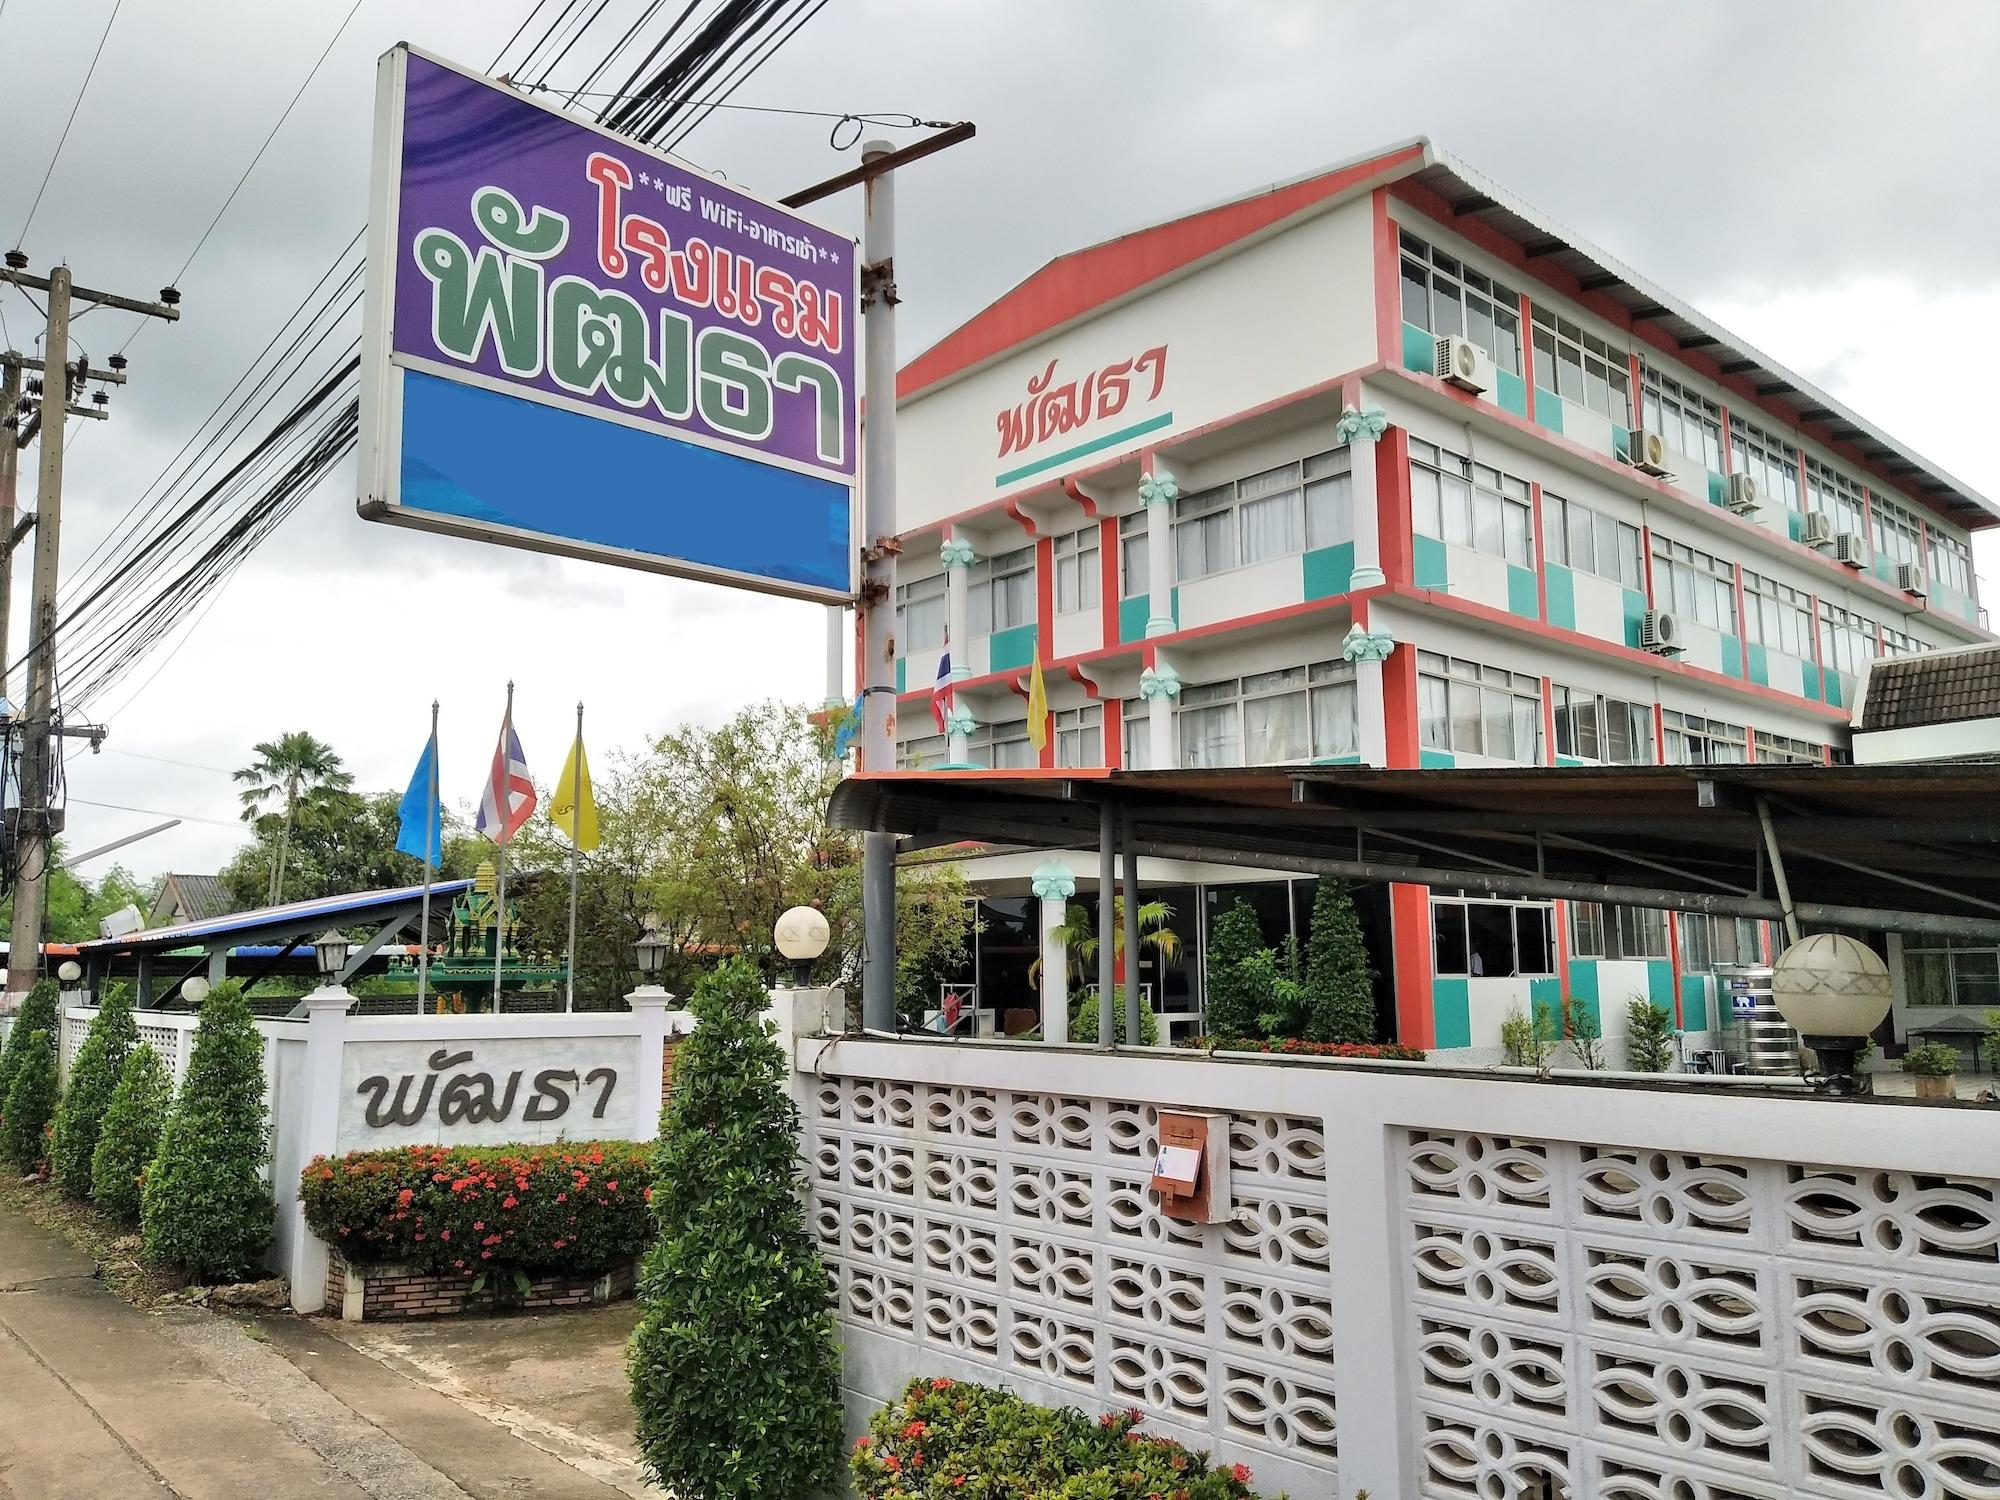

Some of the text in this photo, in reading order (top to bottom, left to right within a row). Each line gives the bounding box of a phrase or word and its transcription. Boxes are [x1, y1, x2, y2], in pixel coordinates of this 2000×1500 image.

[413, 185, 844, 465] พัฒธา
[586, 151, 842, 354] โรงแรม
[996, 343, 1168, 459] พัฒธา
[356, 1049, 618, 1128] พัฒธา
